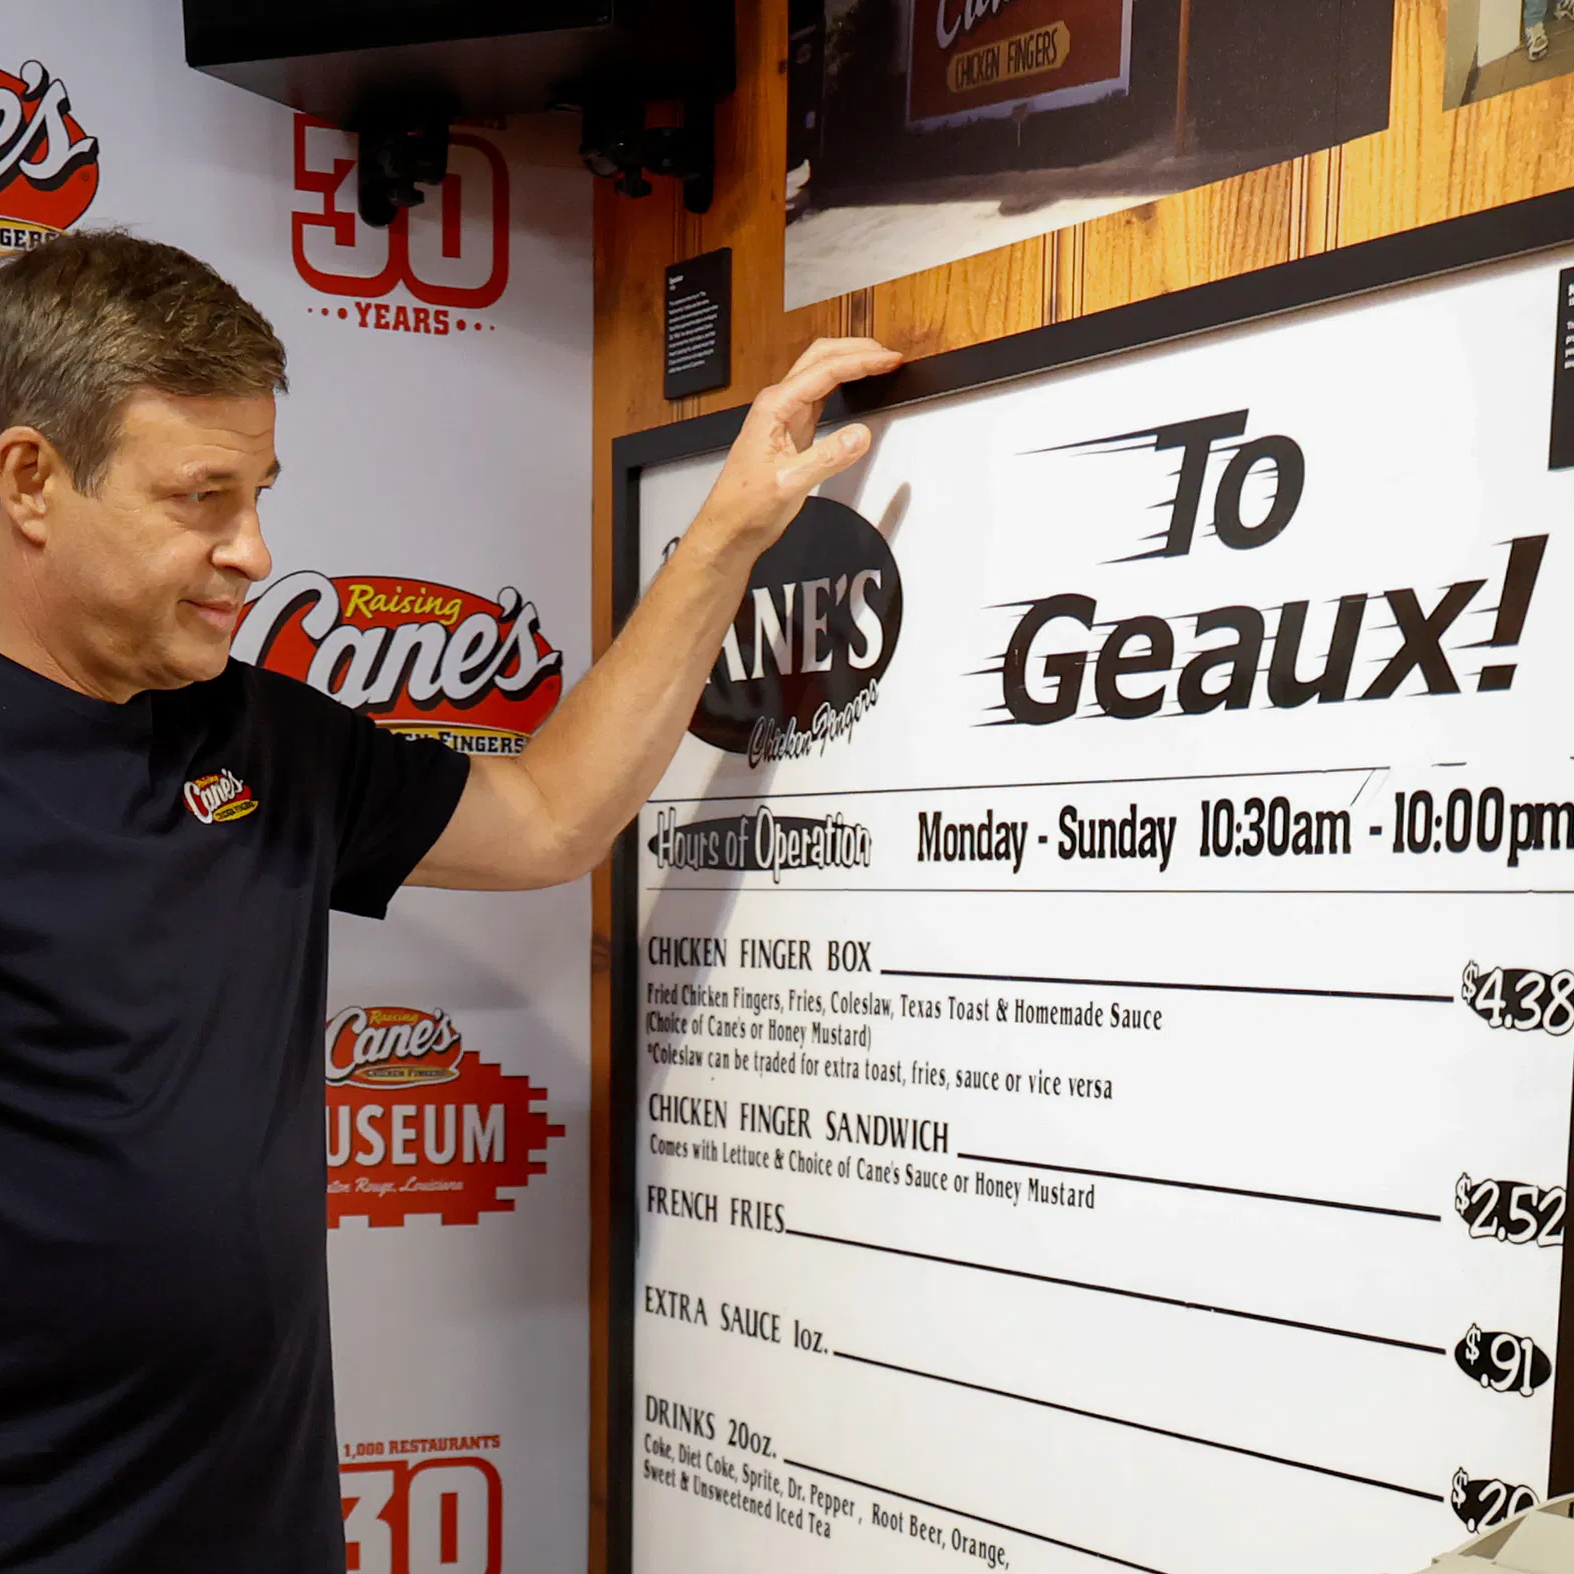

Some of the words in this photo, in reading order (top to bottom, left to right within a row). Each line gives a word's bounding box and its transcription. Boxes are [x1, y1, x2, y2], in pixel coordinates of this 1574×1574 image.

[956, 46, 1000, 89] CHICKEN
[1007, 27, 1058, 74] FINGERS
[1111, 407, 1306, 560] To
[706, 569, 884, 684] ANE'S
[978, 533, 1550, 727] Geaux!
[747, 716, 812, 770] Chicken
[656, 806, 719, 870] Hours
[726, 816, 750, 870] of
[754, 805, 872, 884] Operation
[917, 809, 1028, 874] Monday
[1058, 804, 1177, 872] Sunday
[1199, 796, 1352, 857] 10:30am
[648, 936, 727, 968] CHICKEN
[740, 937, 812, 972] FINGER
[827, 940, 872, 974] BOX
[647, 983, 677, 1007] Fried
[681, 985, 729, 1009] Chicken
[733, 986, 784, 1014] Fingers,
[788, 990, 826, 1015] Fries,
[830, 991, 894, 1019] Coleslaw,
[900, 994, 941, 1019] Texas
[948, 996, 990, 1022] Toast
[996, 998, 1008, 1022] &
[1014, 999, 1104, 1028] Homemade
[1110, 1003, 1163, 1031] Sauce
[707, 1050, 730, 1070] can
[734, 1047, 749, 1072] be
[757, 1049, 796, 1077] traded
[801, 1052, 819, 1076] for
[824, 1058, 860, 1081] extra
[864, 1059, 907, 1085] toast,
[912, 1062, 951, 1091] fries,
[955, 1068, 999, 1091] sauce
[1005, 1071, 1022, 1091] or
[1028, 1069, 1062, 1096] vice
[1067, 1076, 1113, 1099] versa
[648, 1092, 727, 1128] CHICKEN
[740, 1098, 811, 1139] FINGER
[825, 1111, 949, 1153] SANDWICH
[650, 1134, 689, 1160] Comes
[692, 1138, 718, 1163] with
[722, 1142, 770, 1169] Lettuce
[774, 1148, 785, 1170] &
[788, 1148, 833, 1177] Choice
[838, 1154, 852, 1179] of
[856, 1157, 900, 1186] Cane's
[905, 1163, 948, 1191] Sauce
[953, 1169, 970, 1191] or
[975, 1171, 1022, 1207] Honey
[1027, 1177, 1095, 1210] Mustard
[647, 1185, 718, 1223] FRENCH
[730, 1197, 786, 1234] FRIES
[1455, 1172, 1566, 1247] $2.52
[645, 1284, 708, 1326] EXTRA
[720, 1302, 781, 1343] SAUCE
[344, 1440, 384, 1458] 1,000
[389, 1434, 501, 1455] RESTAURANTS
[645, 1395, 715, 1441] DRINKS
[728, 1418, 777, 1460] 20oz.
[644, 1432, 676, 1463] Coke,
[679, 1442, 702, 1469] Diet
[706, 1451, 738, 1481] Coke,
[742, 1463, 783, 1497] Sprite,
[787, 1477, 806, 1502] Dr.
[810, 1484, 854, 1519] Pepper
[872, 1502, 904, 1534] Root
[909, 1514, 946, 1549] Beer,
[951, 1527, 1010, 1570] Orange,
